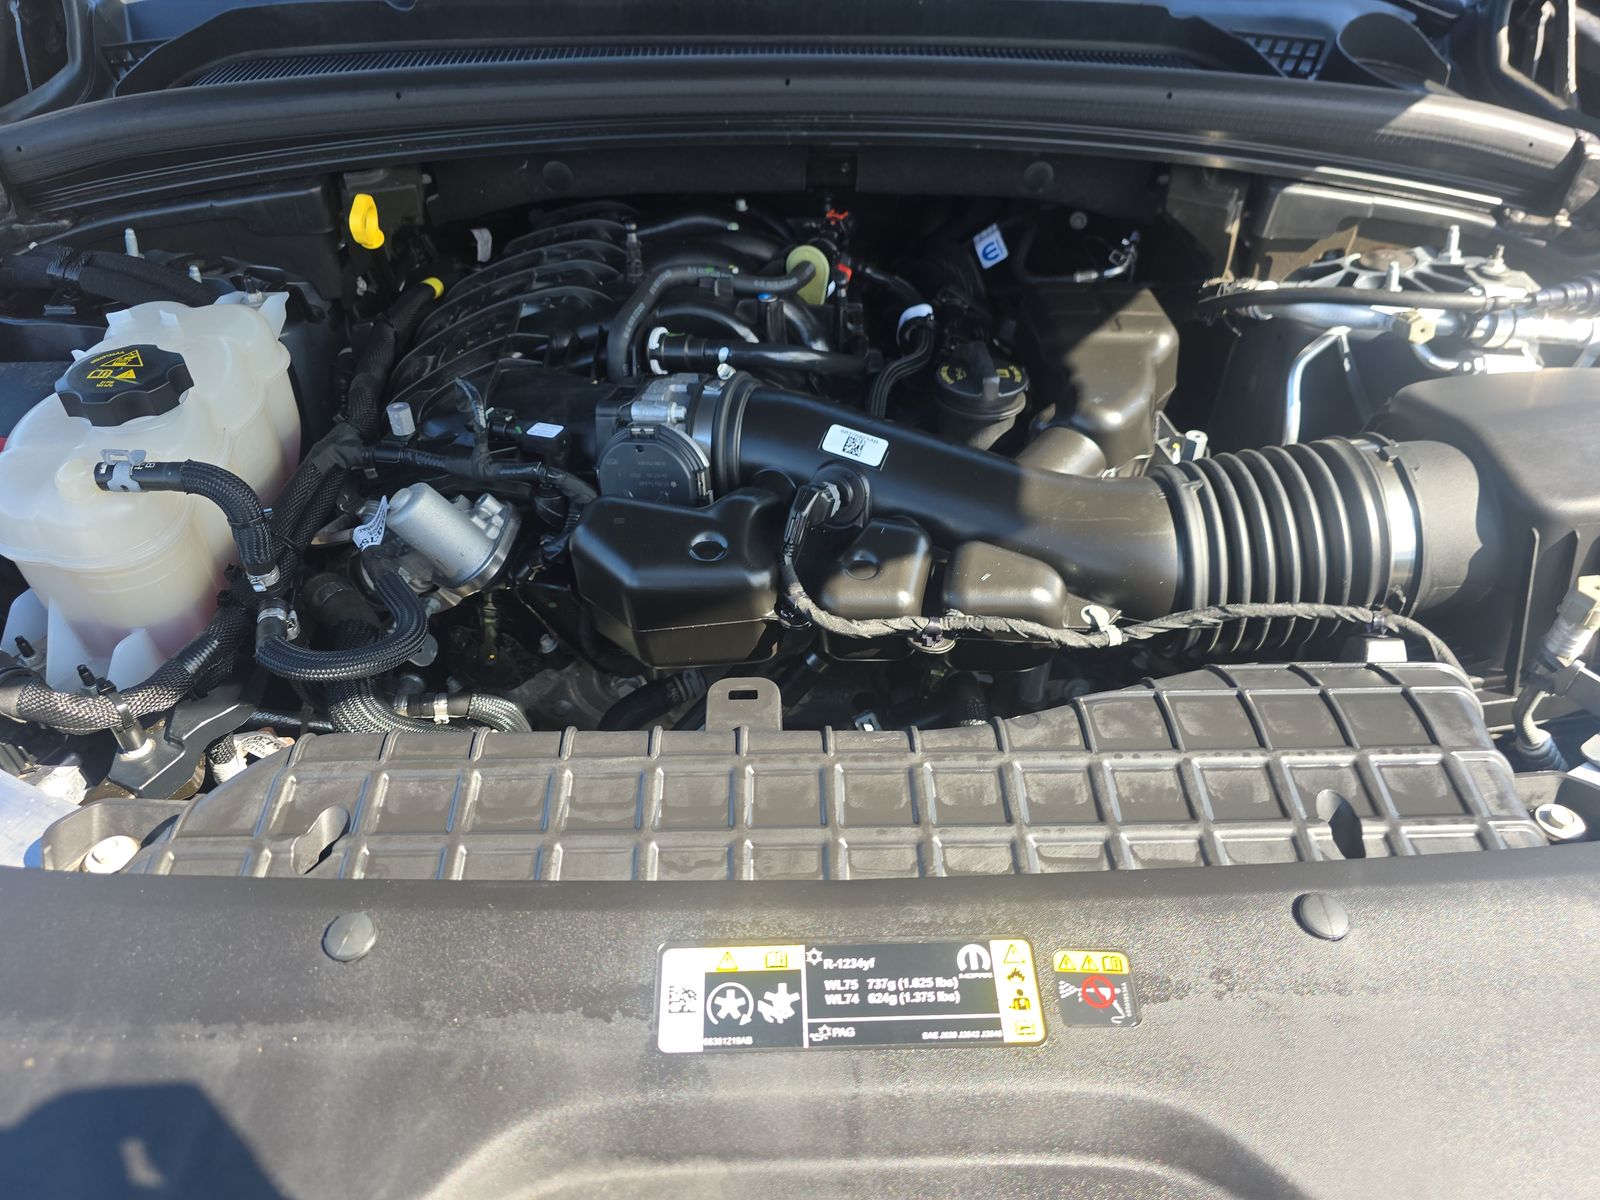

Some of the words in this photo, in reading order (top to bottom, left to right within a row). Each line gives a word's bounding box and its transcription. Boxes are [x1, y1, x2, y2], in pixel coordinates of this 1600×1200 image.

[823, 957, 876, 971] R-1234yf
[824, 979, 859, 991] WL75
[866, 977, 896, 991] 737g
[935, 976, 959, 989] lbs)
[825, 993, 860, 1005] WL74
[899, 991, 936, 1005] (1.375
[937, 990, 961, 1004] lbs)
[832, 1025, 856, 1038] PAG
